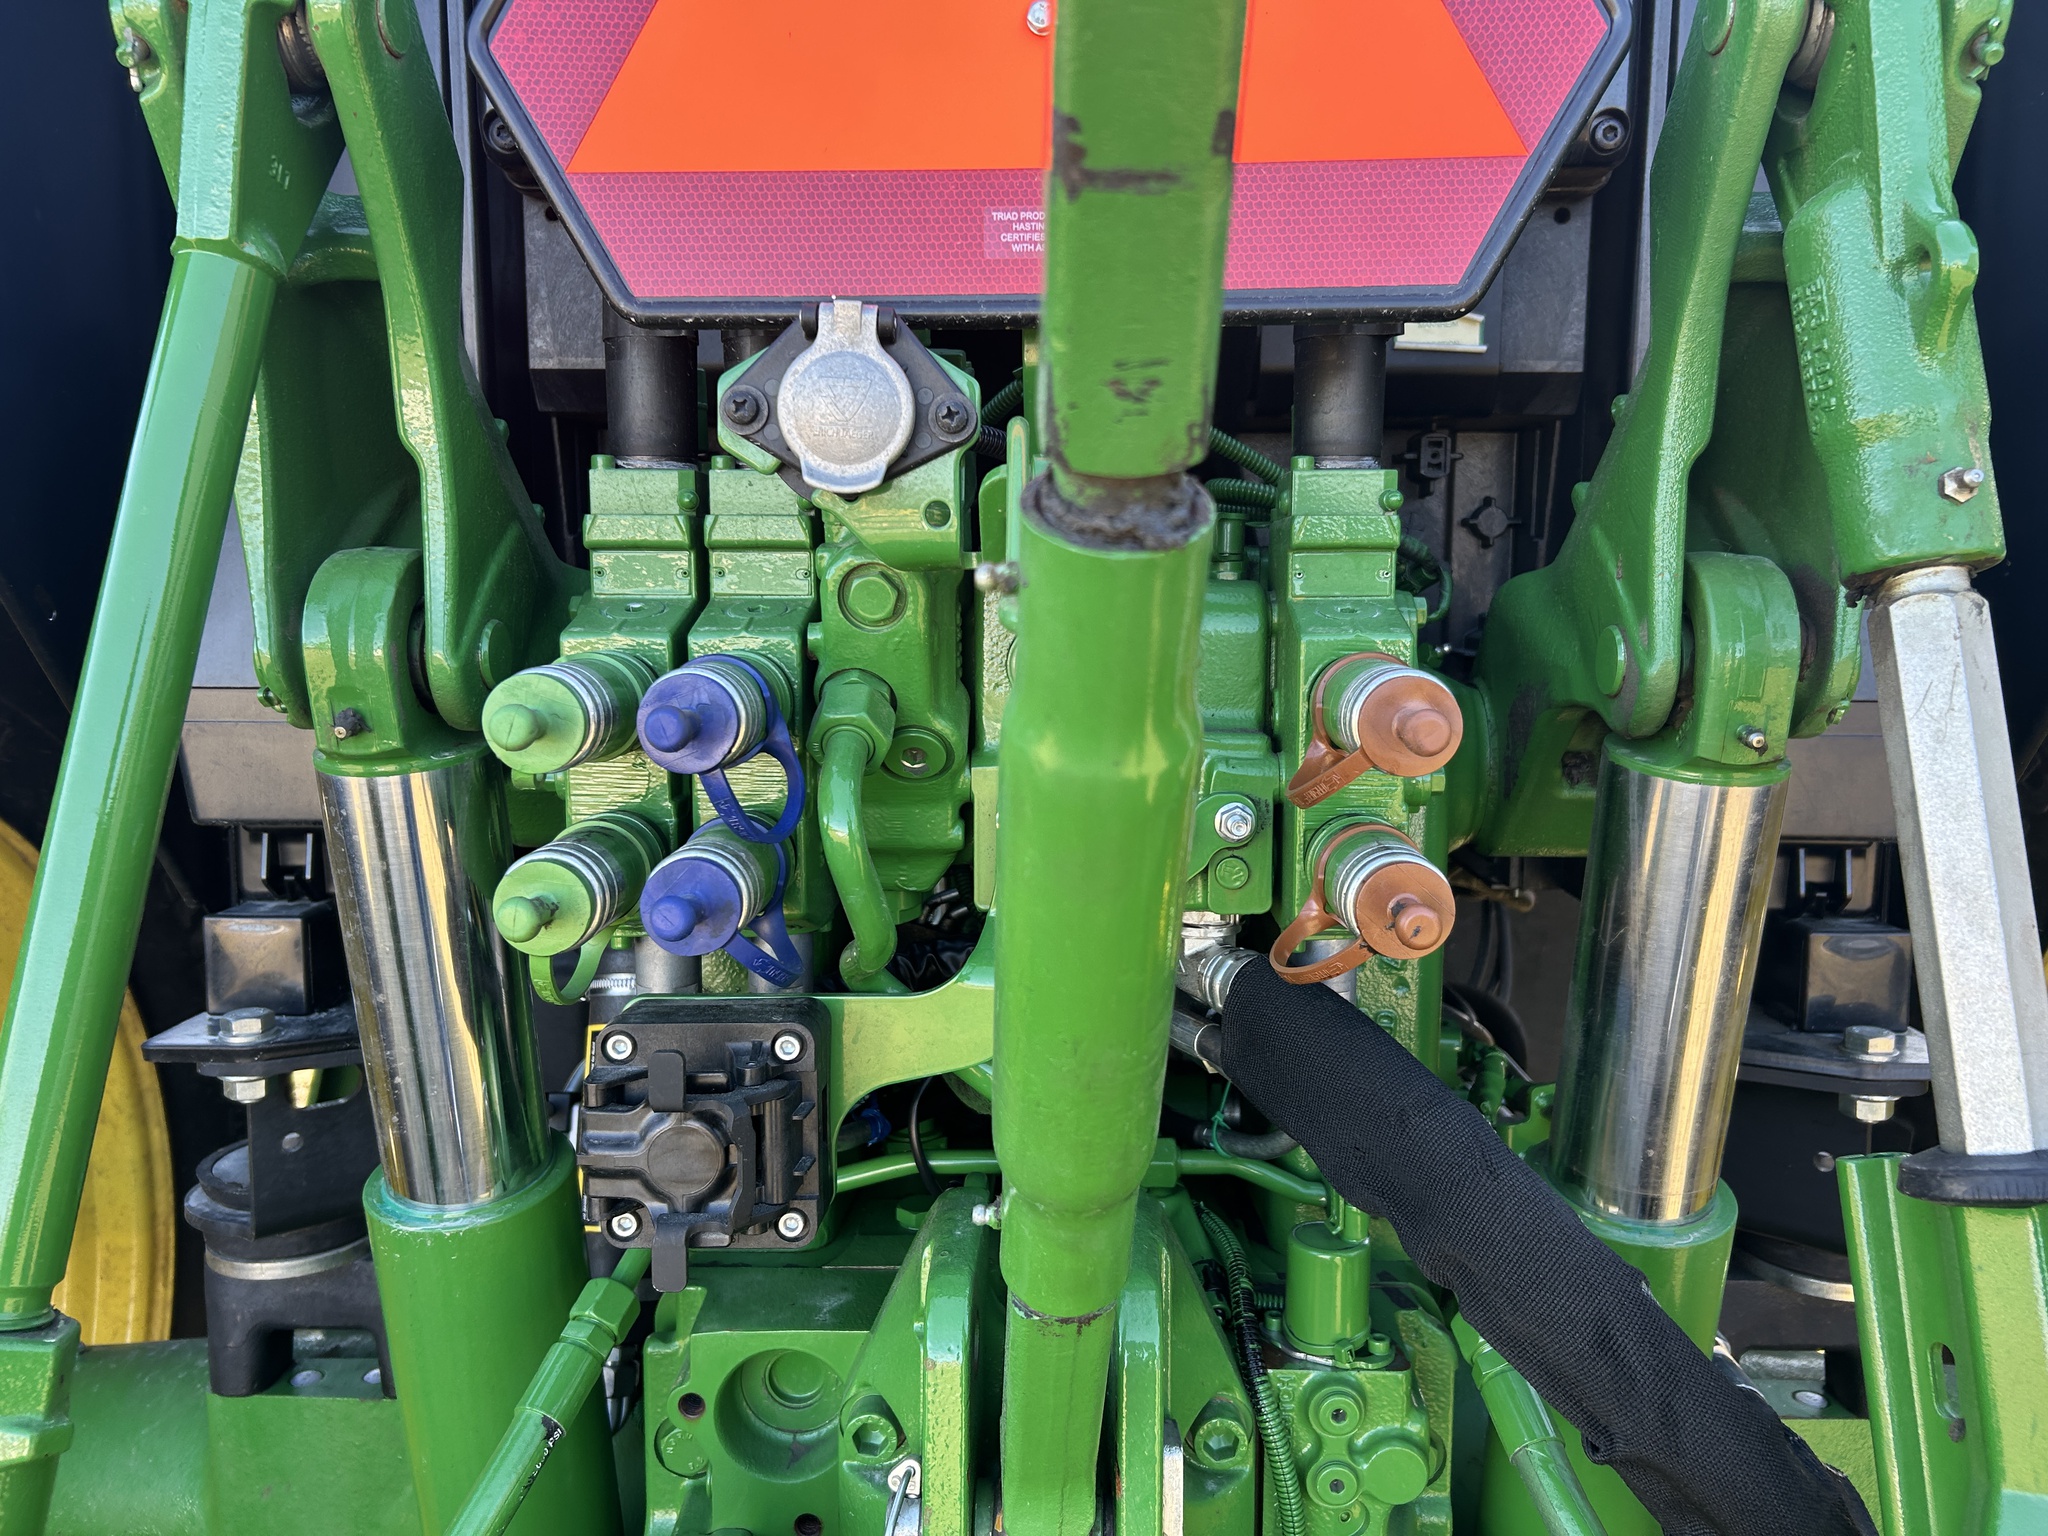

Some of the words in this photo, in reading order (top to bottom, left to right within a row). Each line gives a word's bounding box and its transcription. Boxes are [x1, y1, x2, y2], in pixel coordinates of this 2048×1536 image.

[992, 211, 1018, 221] TRIAD
[1011, 243, 1034, 252] WITH
[547, 1428, 562, 1448] PSI
